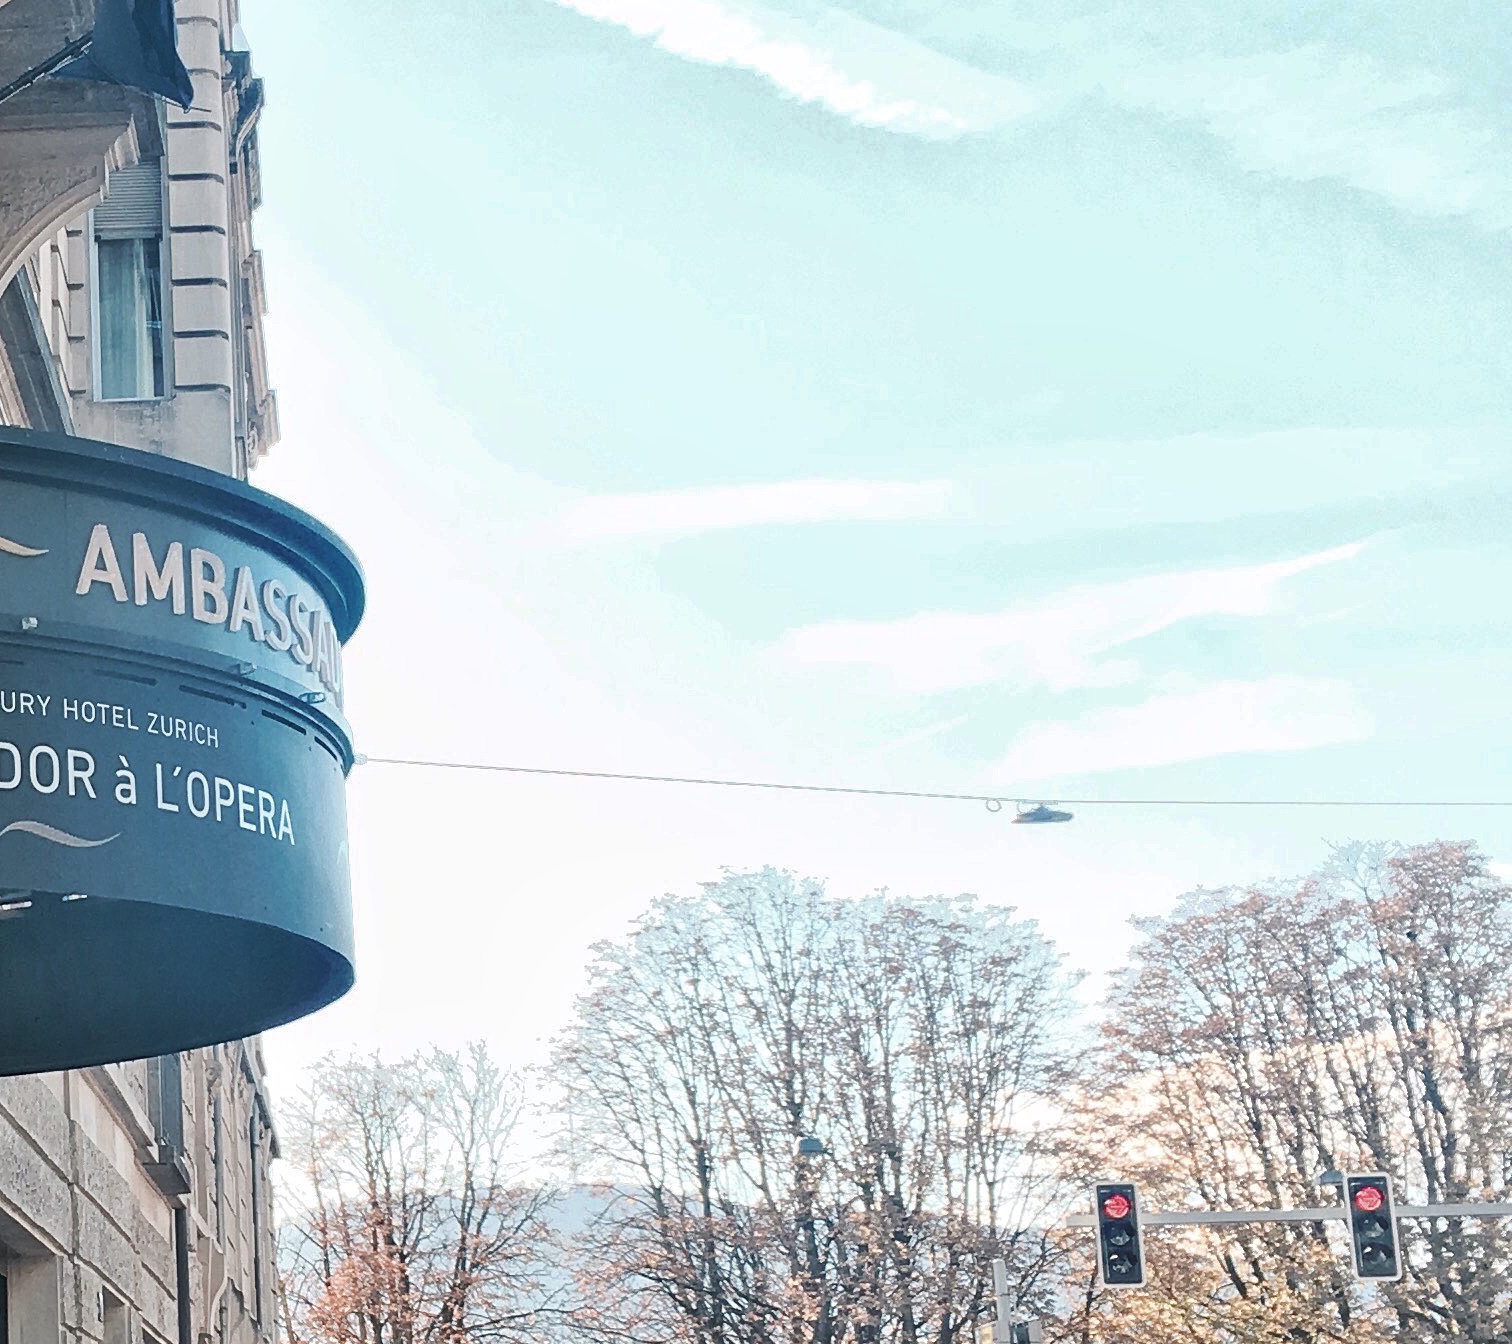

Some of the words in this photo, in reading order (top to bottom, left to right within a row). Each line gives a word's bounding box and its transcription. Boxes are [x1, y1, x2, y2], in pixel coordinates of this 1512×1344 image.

[63, 697, 140, 731] HOTEL
[146, 712, 220, 749] ZURICH
[114, 754, 138, 805] à
